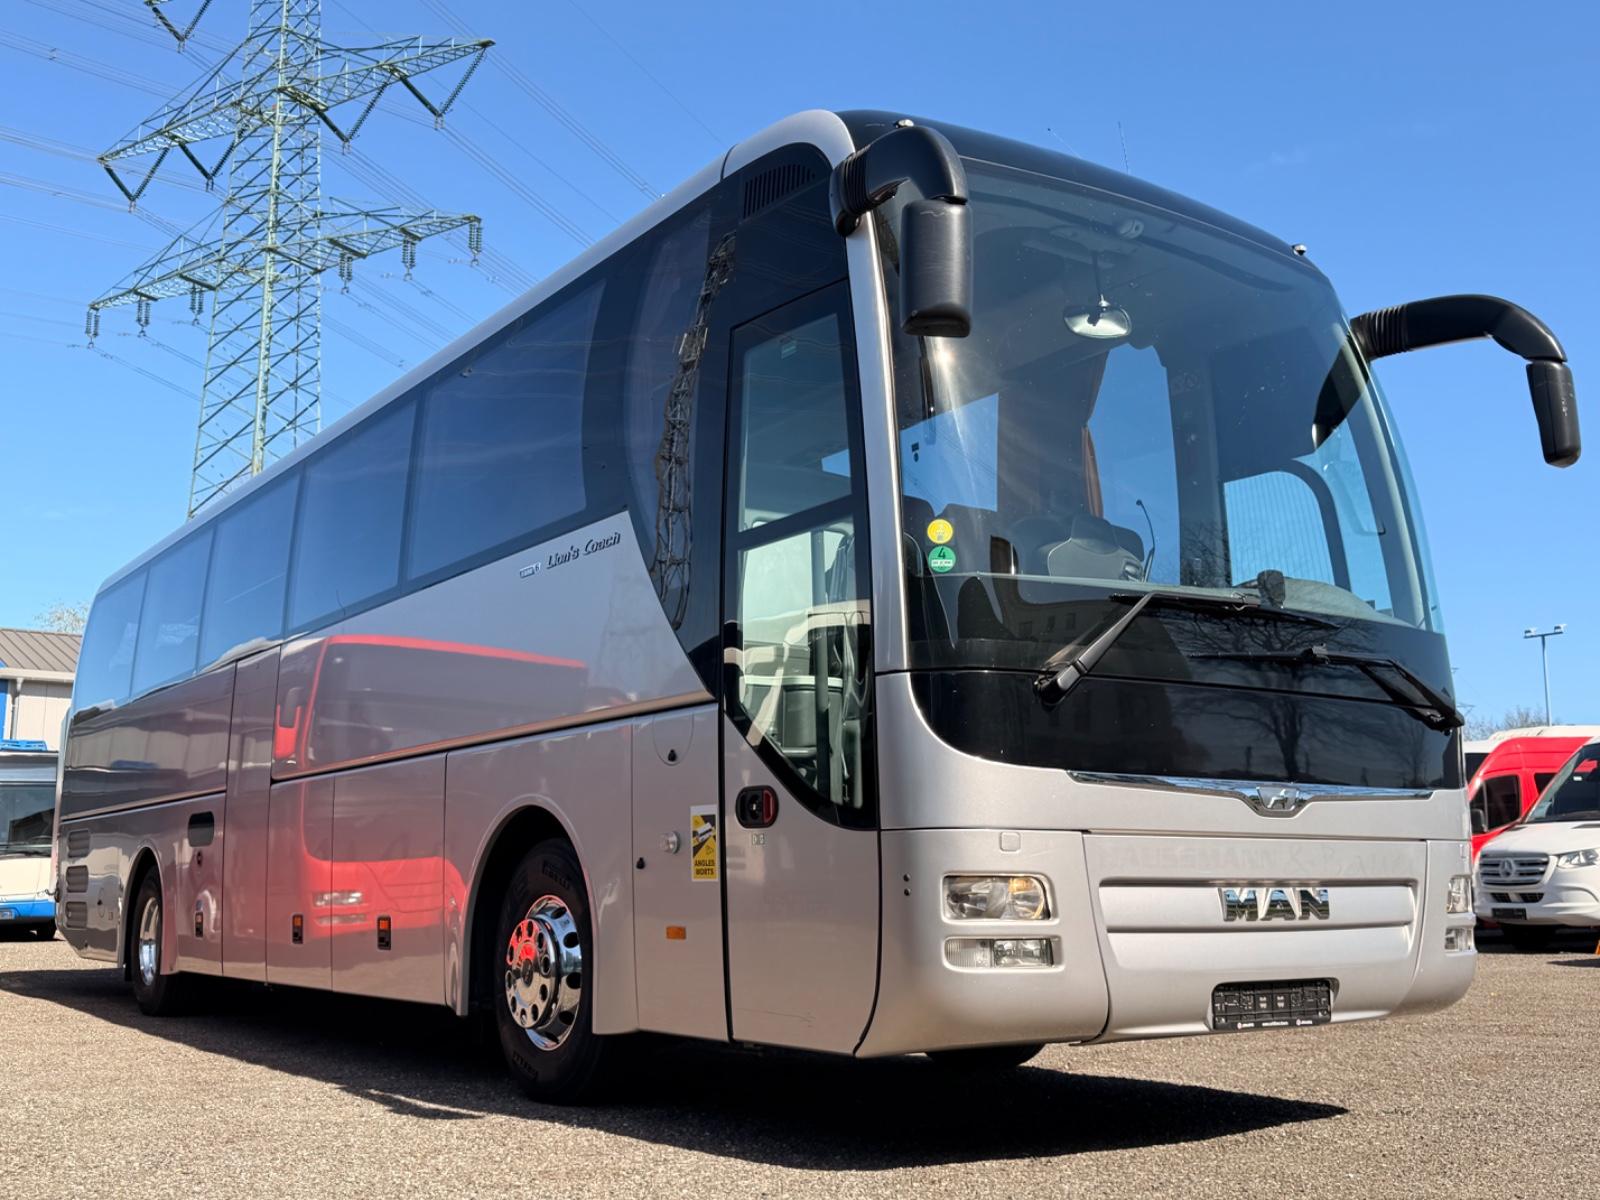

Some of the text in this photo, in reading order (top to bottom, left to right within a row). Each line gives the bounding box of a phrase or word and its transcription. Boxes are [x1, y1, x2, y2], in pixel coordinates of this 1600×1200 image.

[546, 531, 621, 570] Lion's Coach
[938, 548, 946, 559] 4
[694, 859, 715, 867] ANGLES
[696, 868, 714, 876] MORTS
[1217, 887, 1331, 922] MAN
